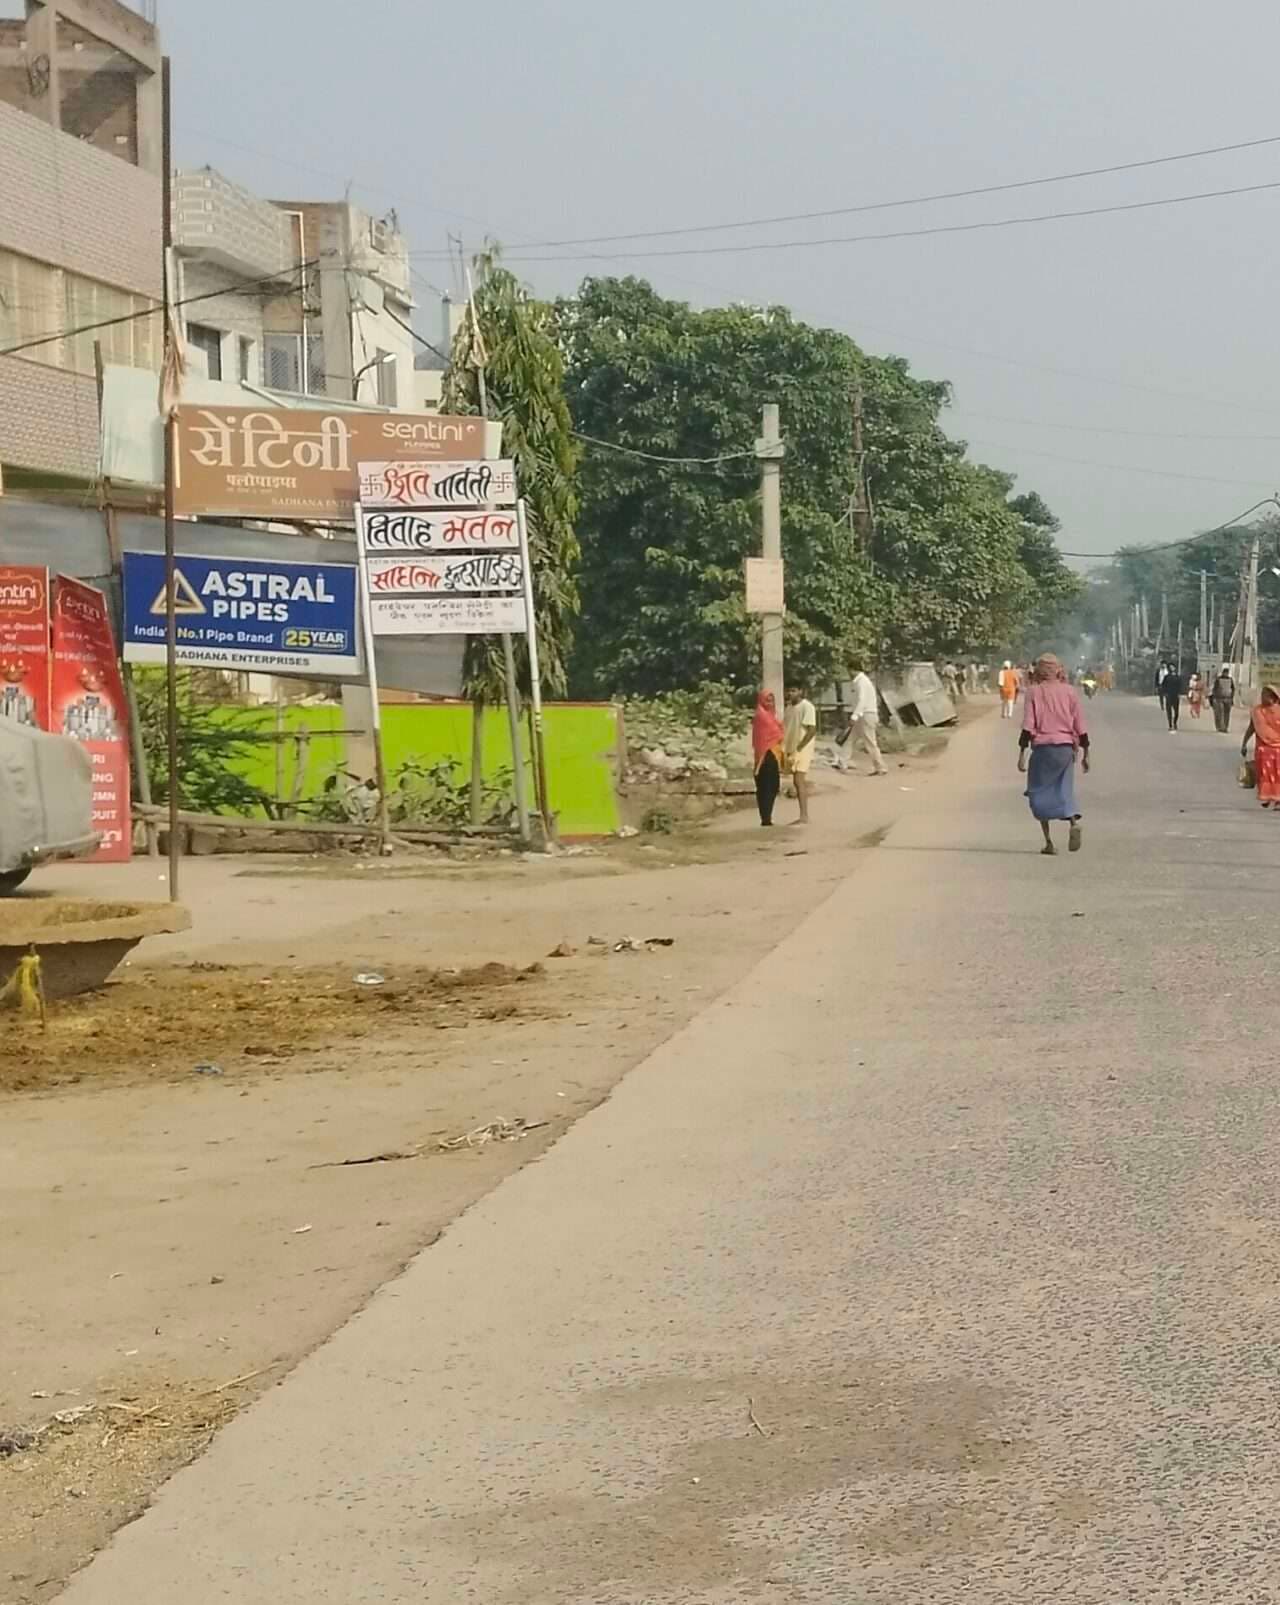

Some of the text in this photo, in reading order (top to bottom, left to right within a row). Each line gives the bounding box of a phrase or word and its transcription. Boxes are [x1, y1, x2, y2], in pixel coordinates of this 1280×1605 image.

[188, 410, 352, 472] सेंटिनी
[382, 420, 463, 442] sentini
[201, 571, 335, 604] ASTRAL
[213, 600, 289, 622] PIPES
[134, 624, 273, 645] India' No.1 Pipe Brand
[285, 630, 344, 648] 25 YEAR
[231, 653, 311, 667] ENTERPRISES
